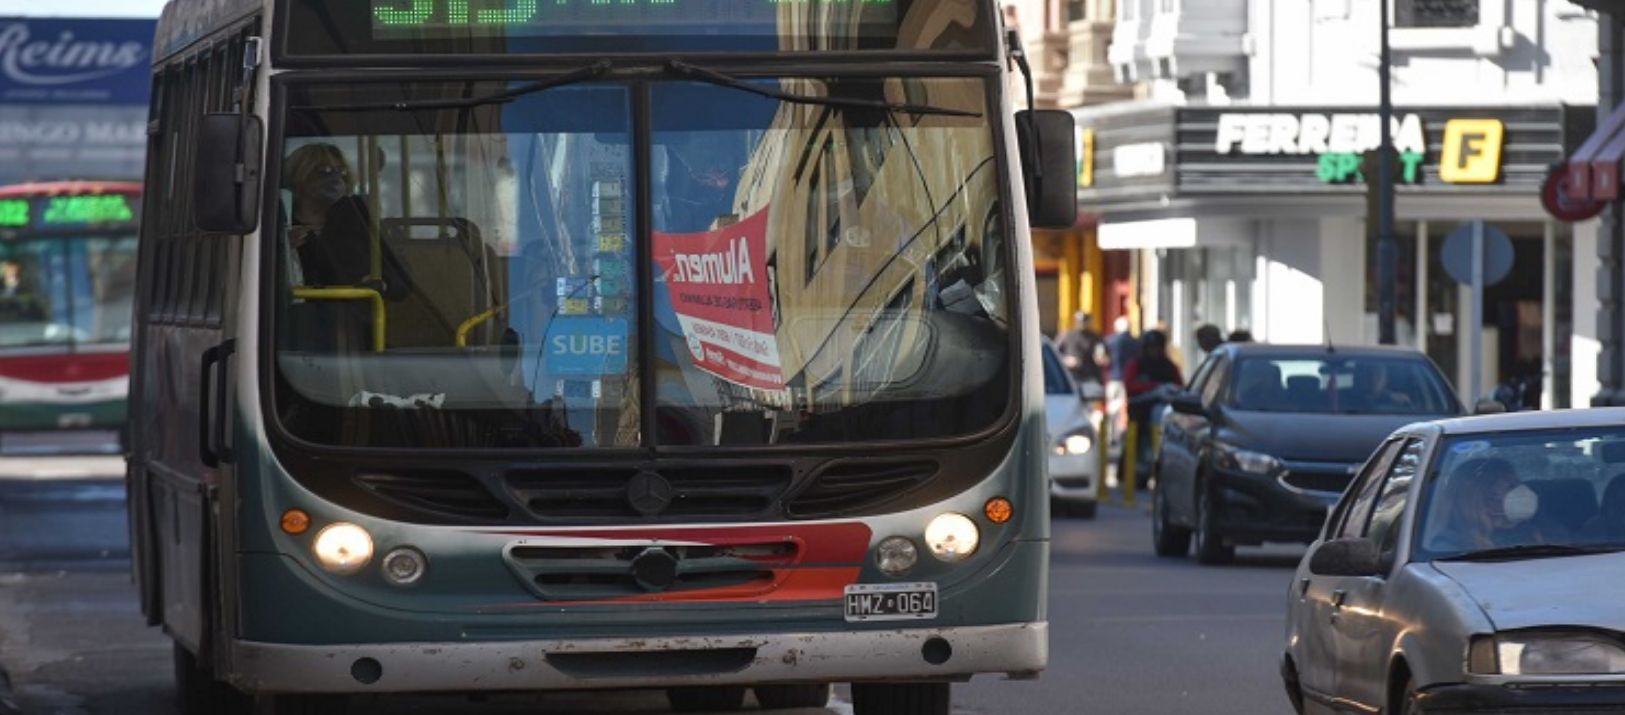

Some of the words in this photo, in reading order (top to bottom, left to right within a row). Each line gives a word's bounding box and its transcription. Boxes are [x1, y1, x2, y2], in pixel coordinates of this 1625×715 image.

[0, 23, 143, 84] Reims
[1457, 132, 1486, 169] F
[553, 335, 622, 355] SUBE
[847, 594, 884, 615] HMZ
[896, 592, 933, 612] 064
